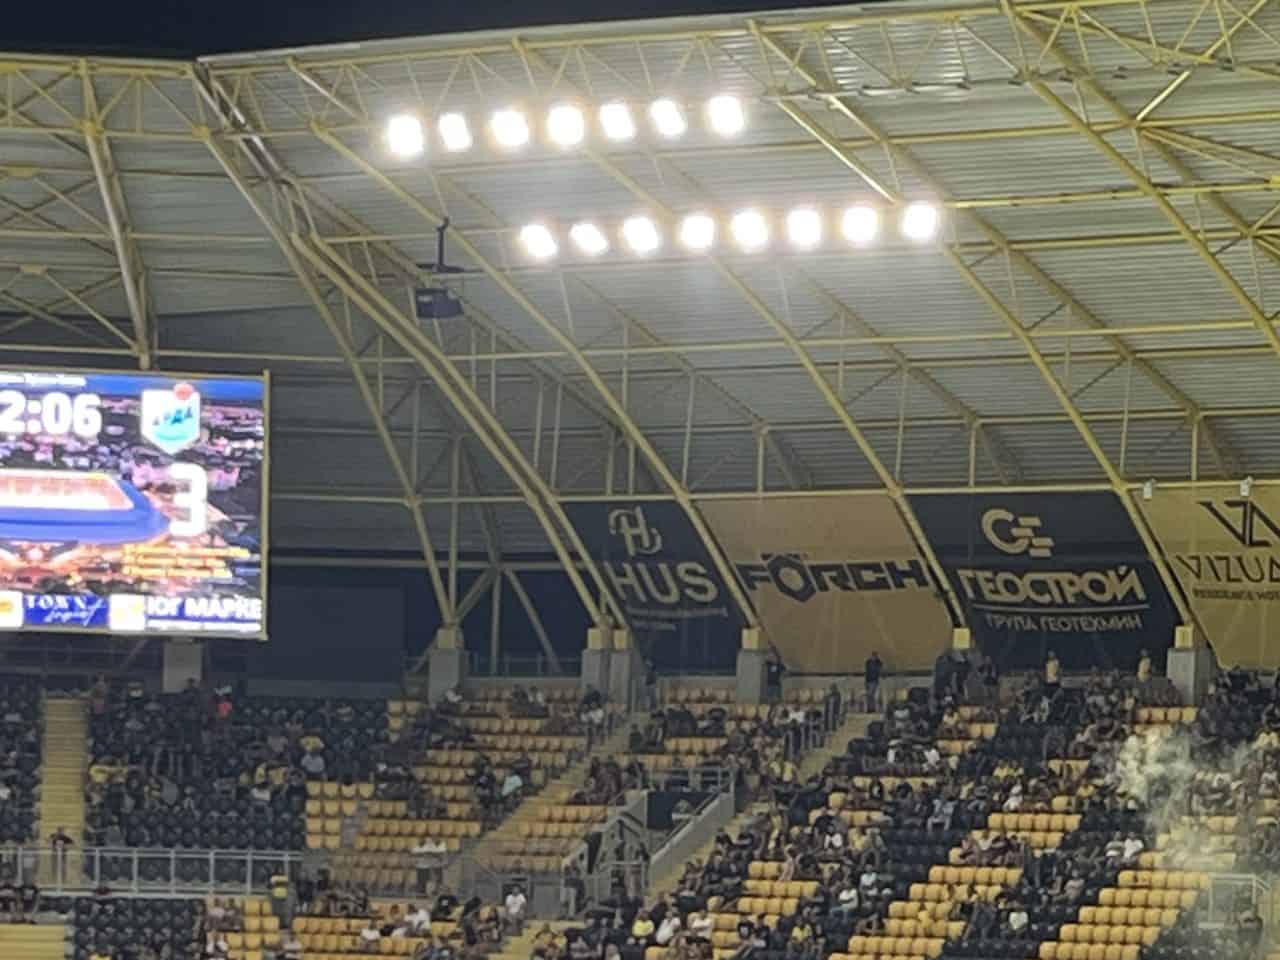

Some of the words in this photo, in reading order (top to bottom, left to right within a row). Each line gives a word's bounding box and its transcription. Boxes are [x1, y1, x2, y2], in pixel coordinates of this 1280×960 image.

[169, 463, 208, 537] 3
[604, 561, 719, 604] HUS
[956, 564, 1147, 604] ГЕОСТРОЙ
